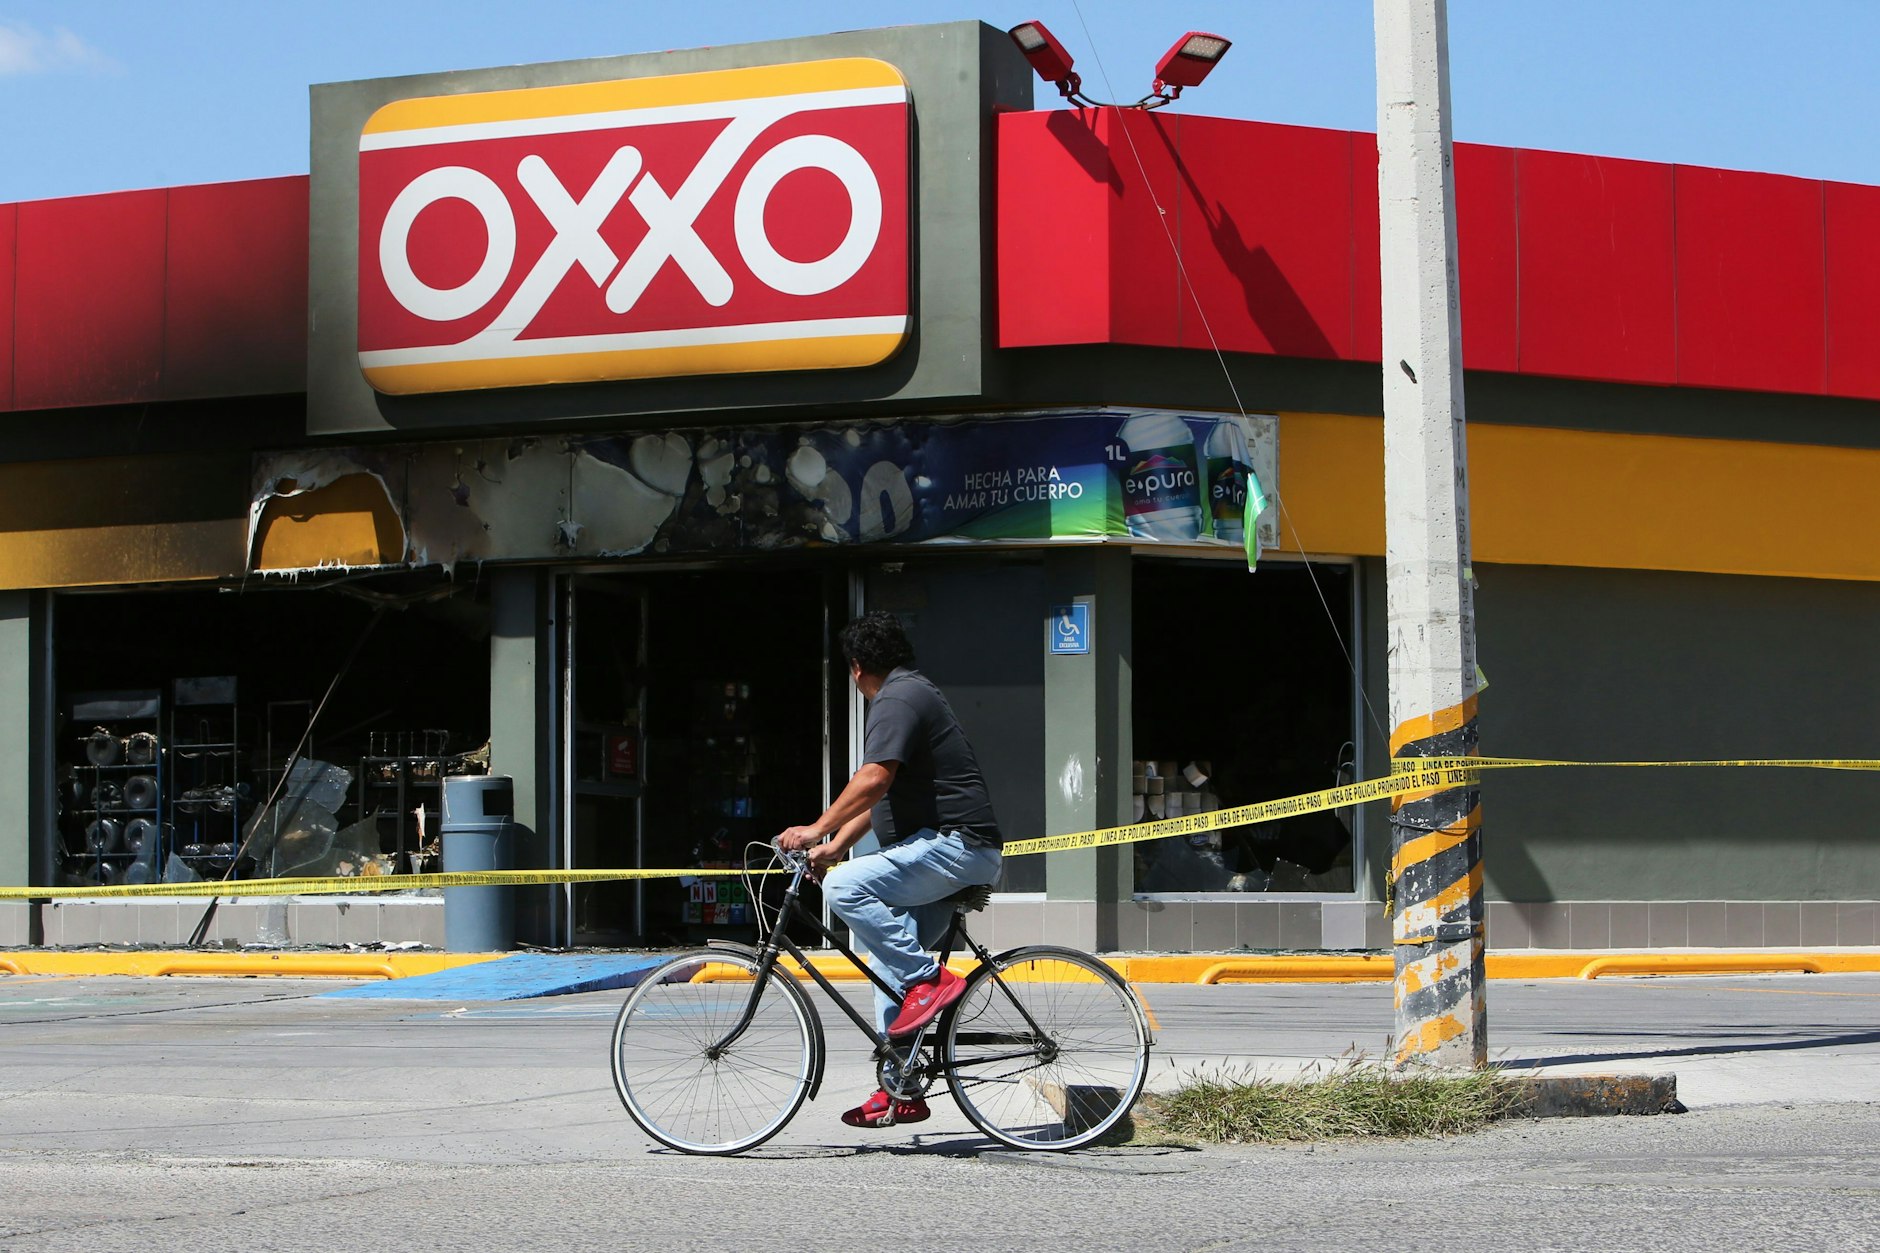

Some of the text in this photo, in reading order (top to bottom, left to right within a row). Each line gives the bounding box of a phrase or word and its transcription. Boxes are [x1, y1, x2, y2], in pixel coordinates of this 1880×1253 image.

[379, 118, 883, 340] OXXO
[1105, 444, 1126, 461] 1L
[965, 466, 1061, 491] HECHA PARA
[943, 482, 1083, 511] AMAR TU CUERPO
[1422, 760, 1442, 771] LINEA
[1444, 760, 1454, 769] DE
[1004, 845, 1012, 854] DE
[1013, 841, 1036, 854] POLICIA
[1037, 837, 1070, 852] PROHIBIDO
[1070, 836, 1078, 847] EL
[1079, 834, 1095, 846] PASO
[1100, 830, 1117, 843] LINEA
[1119, 829, 1127, 840] DE
[1128, 825, 1151, 839] POLICIA
[1152, 820, 1184, 836] PROHIBIDO
[1186, 819, 1193, 831] EL
[1194, 816, 1209, 829] PASO
[1214, 813, 1231, 827] LINEA
[1232, 811, 1240, 823] DE
[1241, 806, 1265, 822] POLICIA
[1265, 799, 1297, 817] PROHIBIDO
[1298, 798, 1305, 811] EL
[1306, 794, 1322, 809] PASO
[1326, 789, 1343, 805] LINEA
[1344, 788, 1353, 801] DE
[1354, 784, 1377, 800] POLICIA
[1378, 778, 1410, 796] PROHIBIDO
[1412, 775, 1421, 788] EL
[1422, 771, 1440, 786] PASO
[1447, 770, 1466, 783] LINEA
